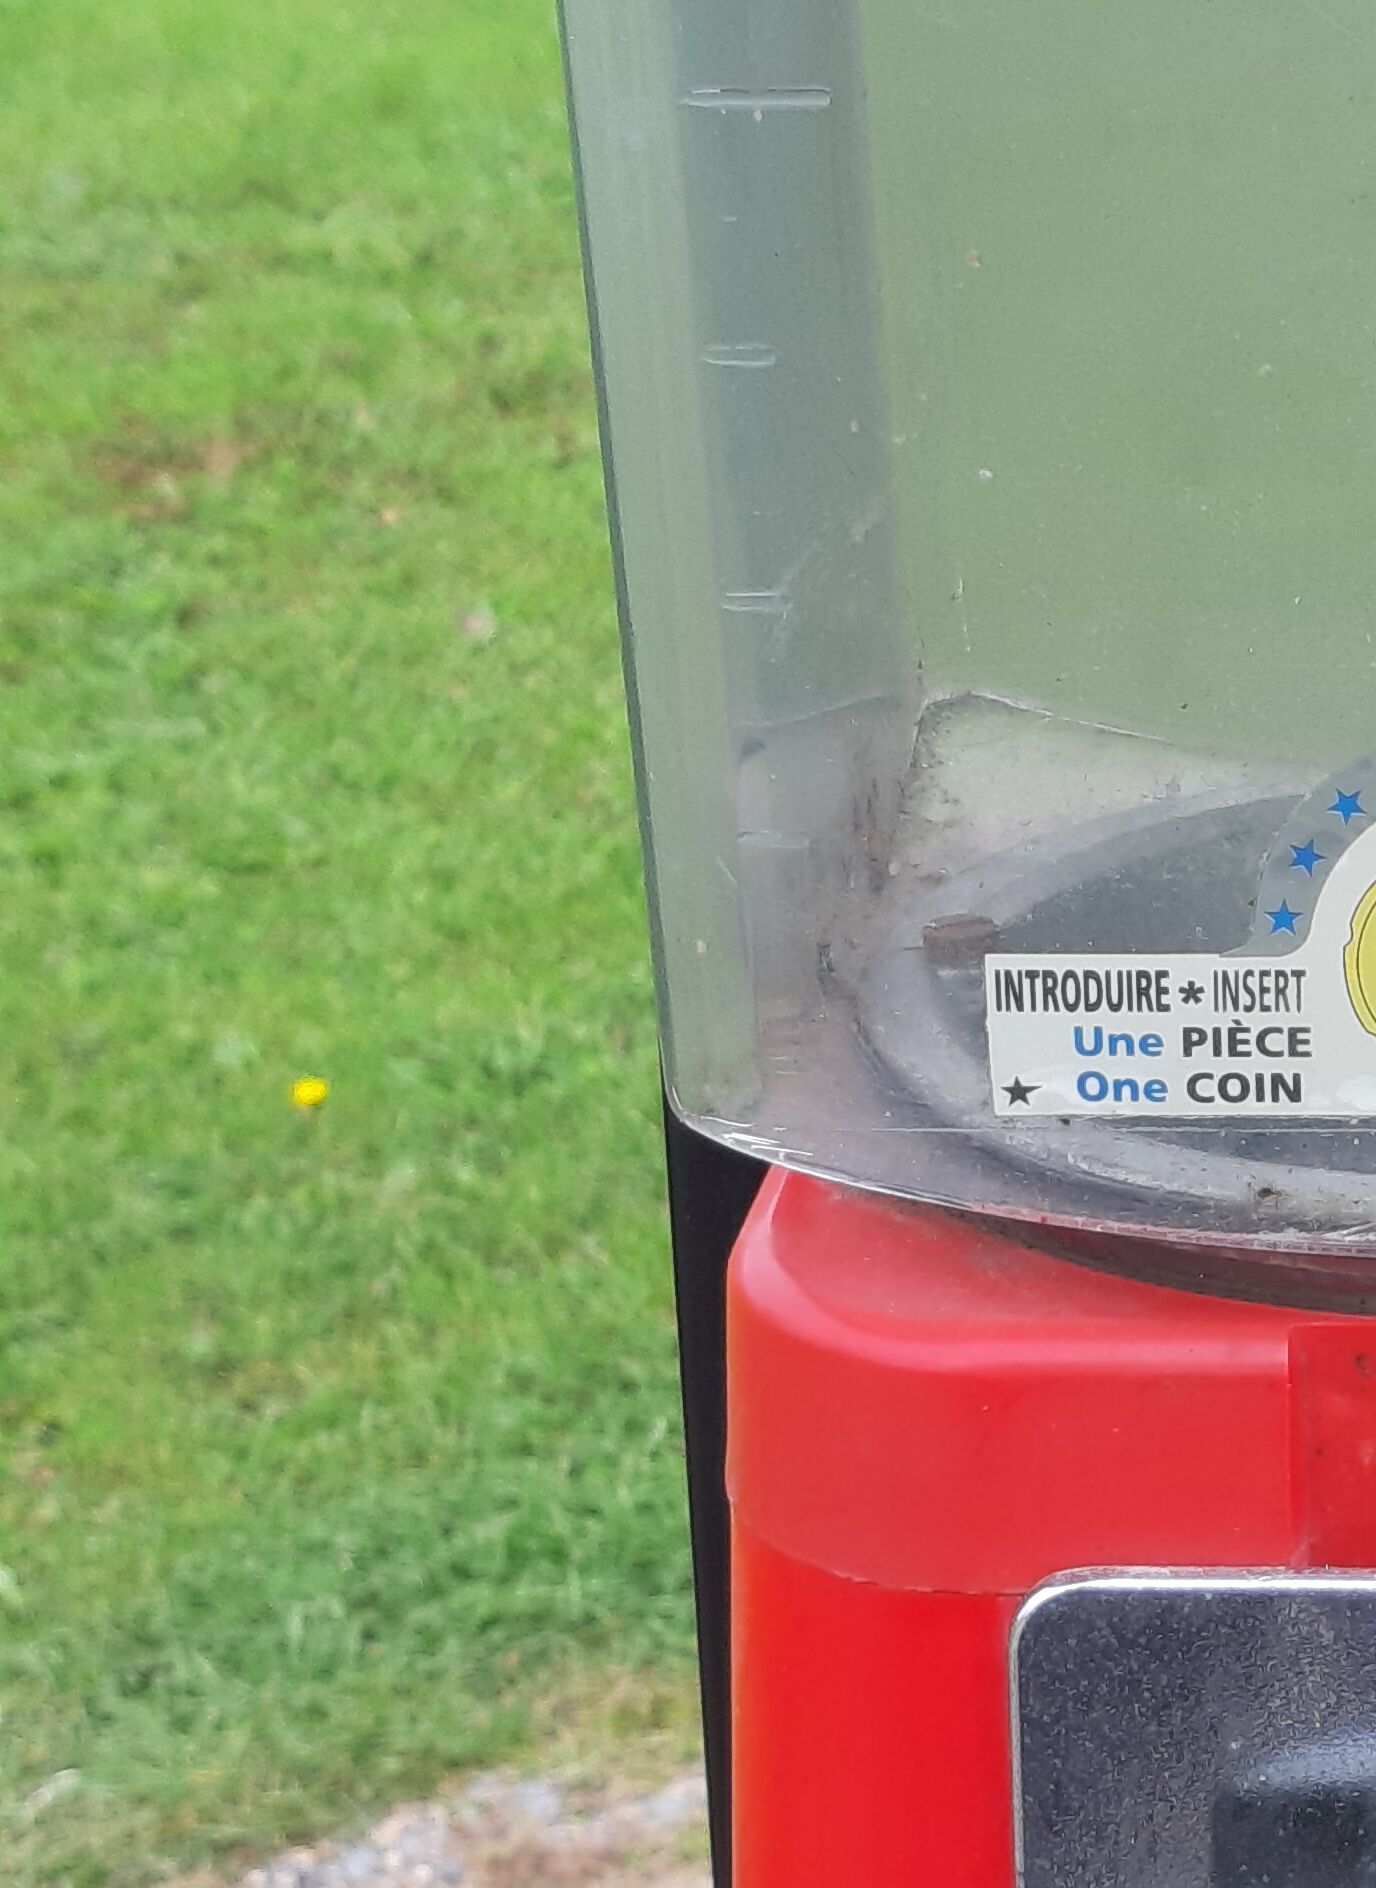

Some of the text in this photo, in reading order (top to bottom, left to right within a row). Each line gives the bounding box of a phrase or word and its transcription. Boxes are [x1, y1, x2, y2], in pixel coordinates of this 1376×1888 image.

[994, 968, 1307, 1014] INTRODUIRE INSERT
[1073, 1018, 1313, 1058] Une PIÈCE
[1076, 1070, 1302, 1104] One COIN
